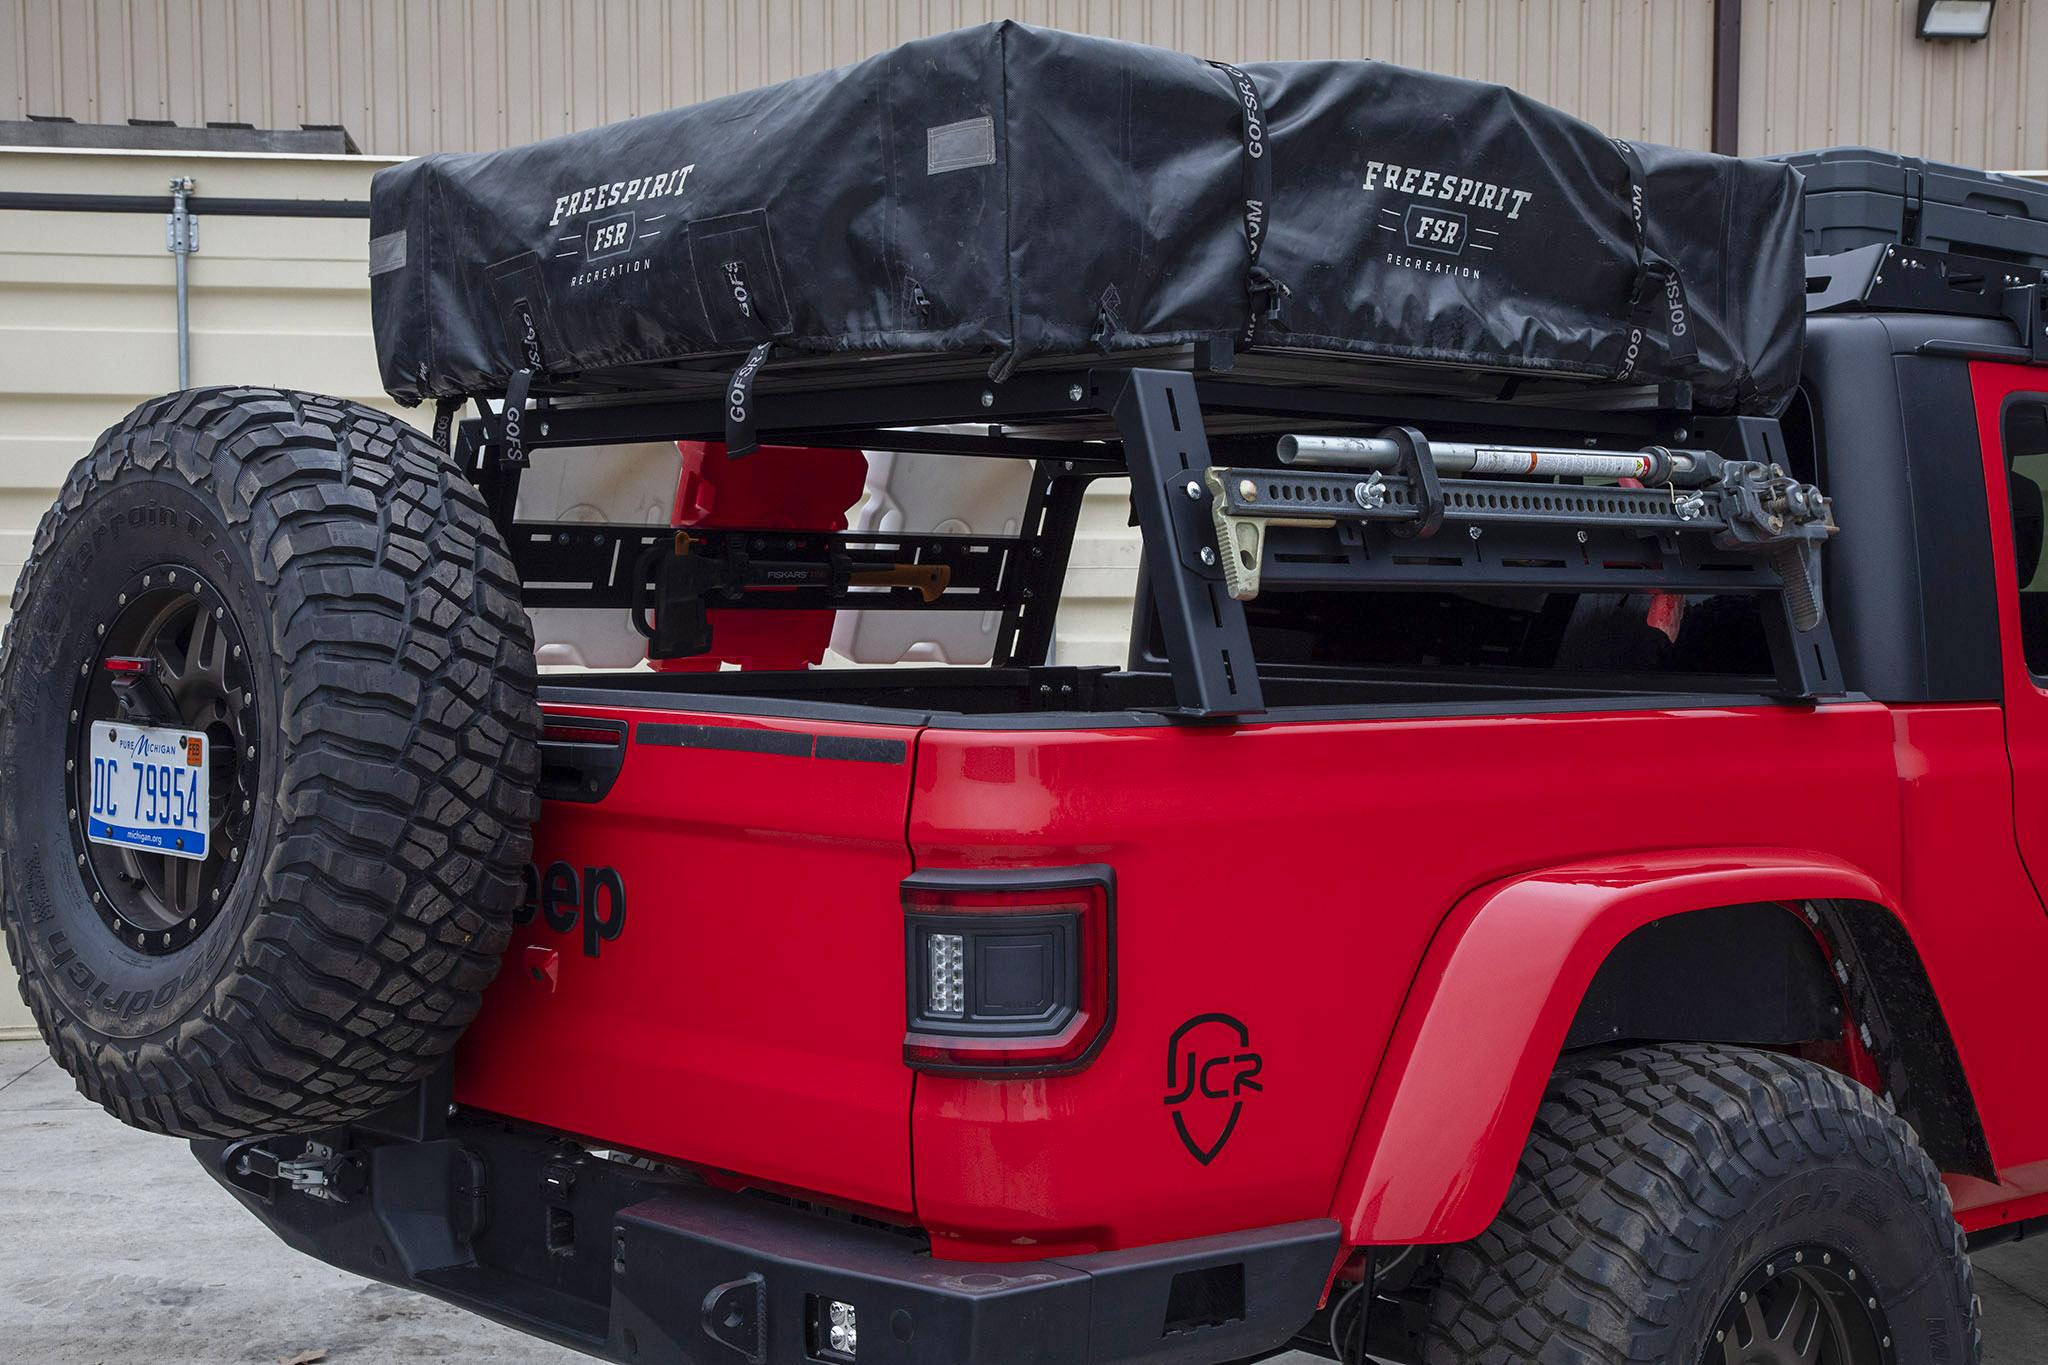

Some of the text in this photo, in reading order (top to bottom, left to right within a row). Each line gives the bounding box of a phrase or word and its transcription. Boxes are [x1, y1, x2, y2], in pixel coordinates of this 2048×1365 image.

[549, 164, 695, 226] FREESPIRIT
[1362, 161, 1533, 220] FREESPIRIT
[593, 222, 628, 251] FSR
[1416, 216, 1459, 244] FSR
[571, 258, 650, 287] RECREATION
[1387, 253, 1480, 279] RECREATION
[506, 407, 523, 461] GOFS
[767, 571, 808, 579] FISKARS
[119, 735, 176, 758] PURE MICHIGAN
[188, 744, 200, 756] FEB
[93, 757, 198, 829] DC 79954
[127, 831, 162, 846] michigan.org
[1164, 1052, 1263, 1105] JCR
